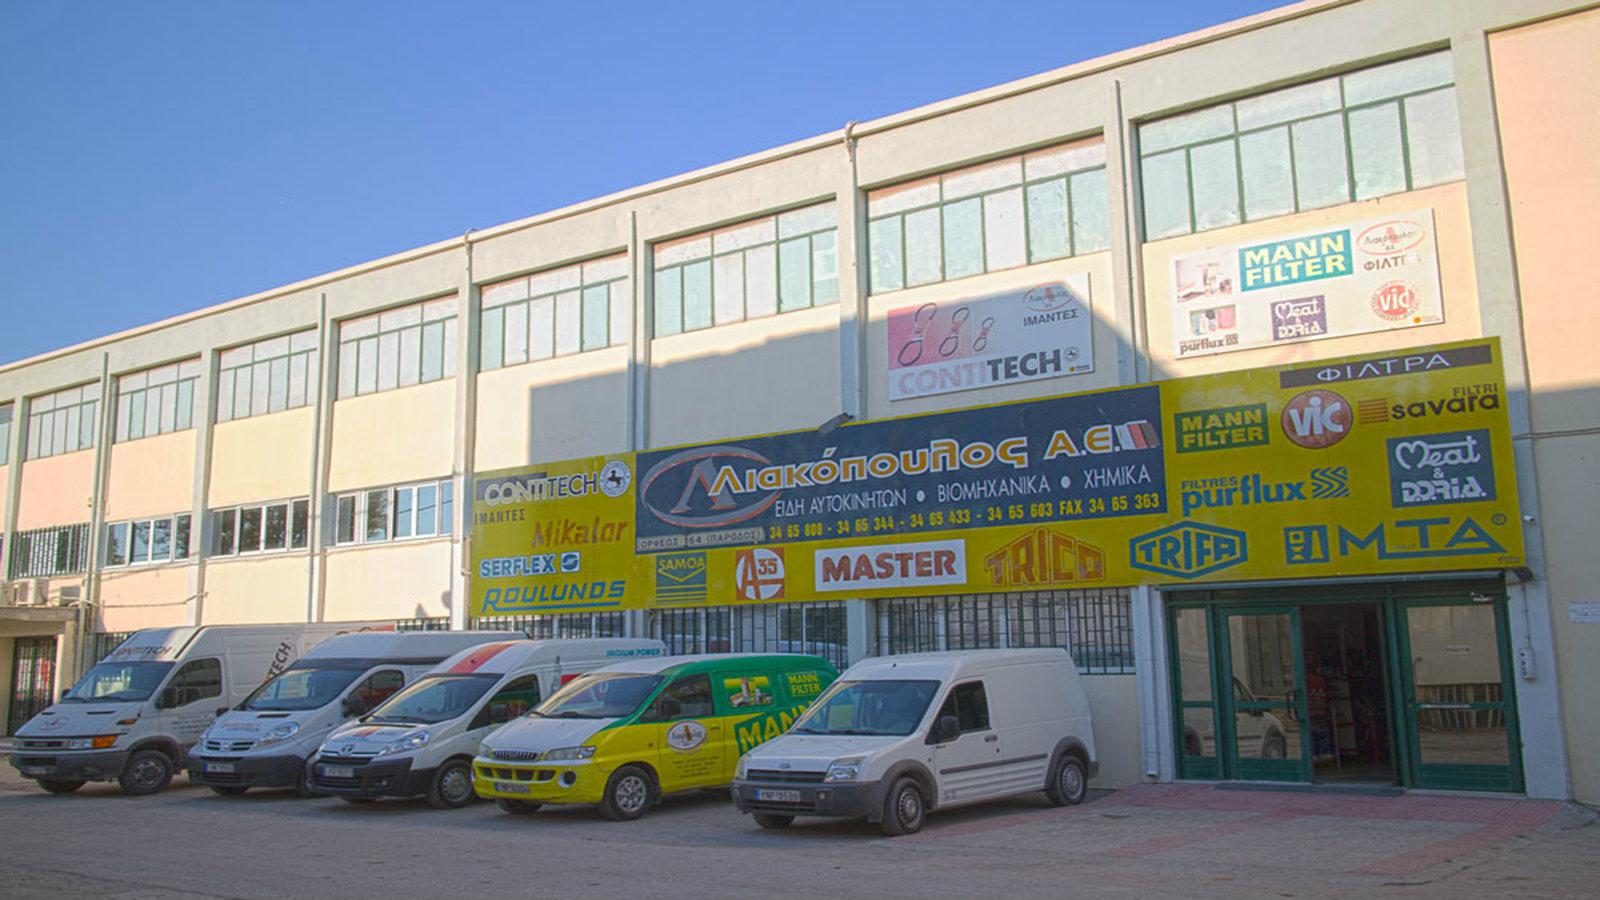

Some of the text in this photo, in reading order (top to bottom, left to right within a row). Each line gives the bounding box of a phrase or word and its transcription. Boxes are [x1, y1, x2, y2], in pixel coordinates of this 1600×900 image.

[1245, 234, 1345, 268] MANN
[1246, 254, 1346, 286] FILTER
[1023, 308, 1079, 327] ΙΜΑΝΤΕΣ
[1180, 337, 1224, 355] purflux
[900, 349, 1061, 394] CONTITECH
[1316, 353, 1452, 382] ΦΙΛΤΡΑ
[1453, 383, 1499, 397] FILTRI
[1181, 408, 1263, 433] MANN
[1391, 394, 1499, 420] savara
[1181, 428, 1264, 449] FILTER
[1395, 435, 1481, 470] Meat
[708, 424, 1120, 497] Λιακόπουλος Α.Ε.
[1433, 467, 1445, 479] &
[484, 472, 597, 506] CONTITECH
[775, 463, 1152, 517] ΕΙΔΗ ΑΥΤΟΚΙΝΗΤΩΝ ΒΙΟΜΗΧΑΝΙΚΑ ΧΗΜΙΚΑ
[1181, 475, 1238, 490] FILTRES
[1181, 473, 1307, 517] purflux
[474, 509, 526, 526] ΙΜΑΝΤΕΣ
[769, 526, 782, 539] 34
[786, 524, 800, 538] 65
[837, 520, 850, 534] 34
[855, 517, 869, 532] 65
[873, 516, 895, 531] 344
[910, 513, 924, 528] 34
[929, 511, 943, 526] 65
[948, 509, 971, 524] 433
[987, 506, 1002, 521] 34
[1008, 504, 1024, 519] 65
[1060, 498, 1083, 515] FAX
[1089, 497, 1105, 513] 34
[1111, 495, 1128, 511] 65
[1135, 492, 1160, 510] 363
[658, 556, 706, 572] SAMOA
[985, 526, 1106, 587] TRICO
[1139, 529, 1238, 571] TRIFA
[479, 554, 555, 578] SERFLEX
[758, 557, 778, 575] 35
[821, 549, 957, 582] MASTER
